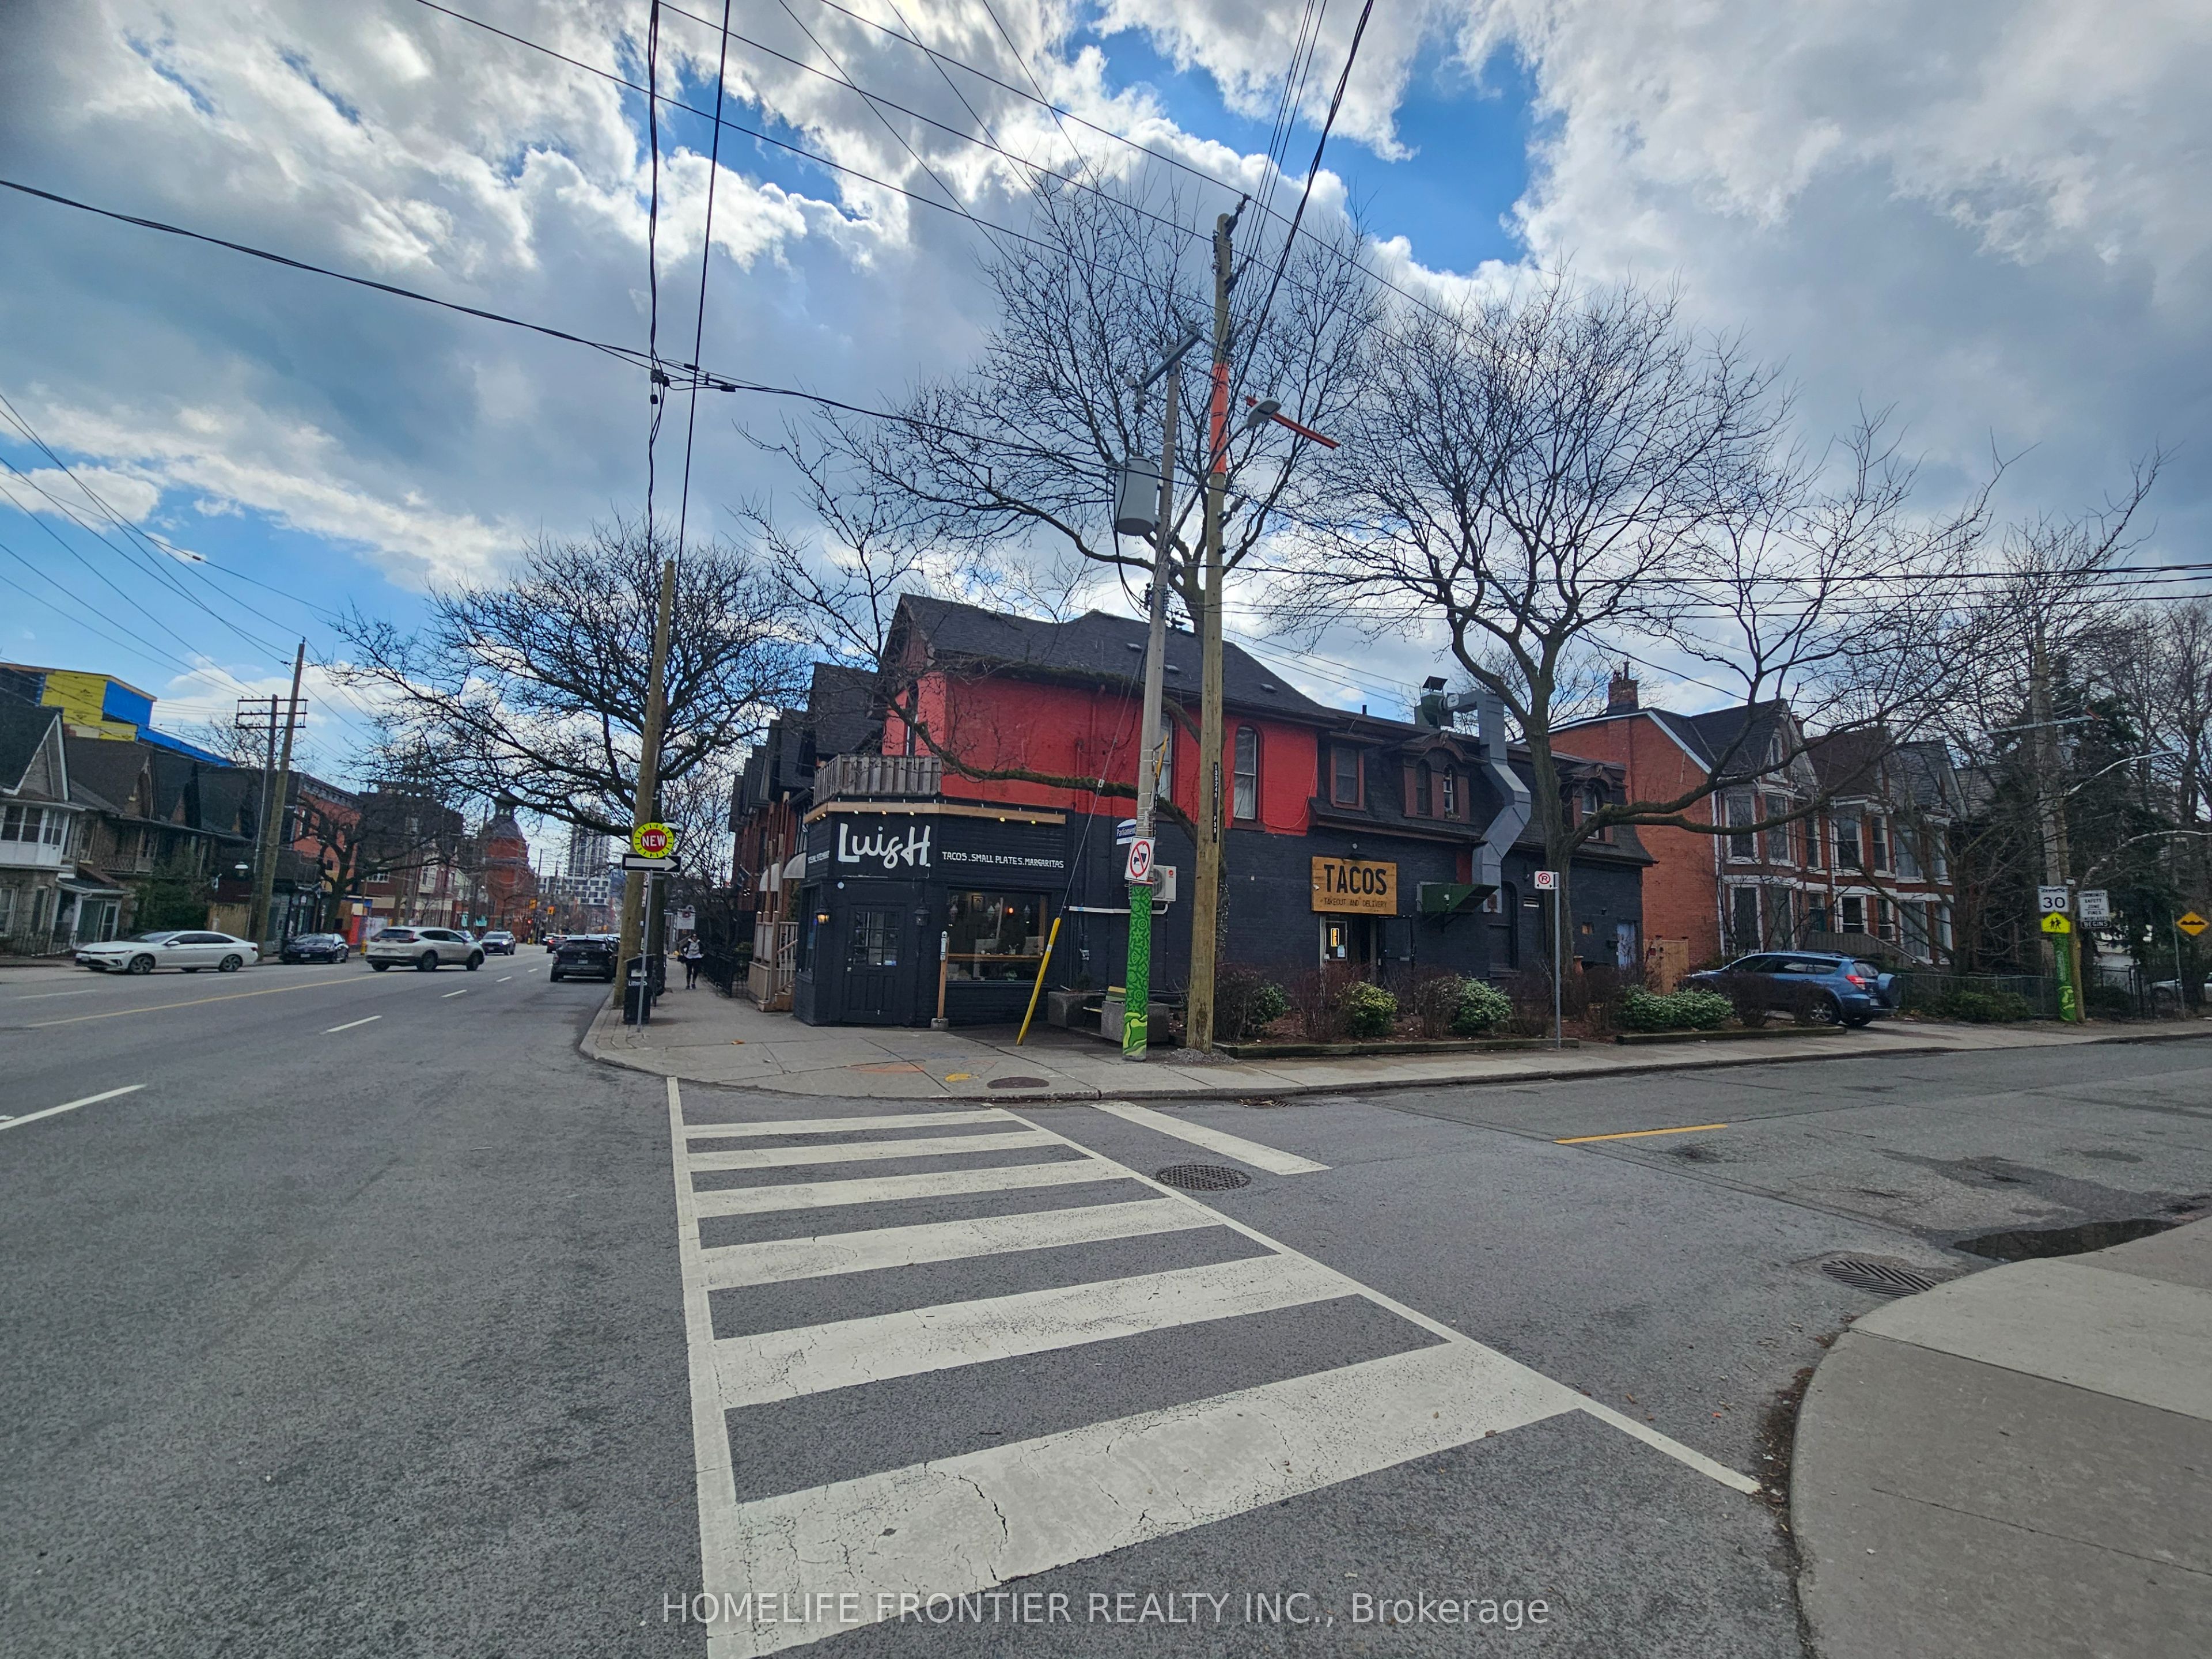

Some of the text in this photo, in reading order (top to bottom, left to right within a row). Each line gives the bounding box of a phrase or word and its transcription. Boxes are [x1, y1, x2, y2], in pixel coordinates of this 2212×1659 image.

[642, 835, 666, 847] NEW
[942, 851, 967, 861] TACOS
[1324, 864, 1387, 896] TACOS
[1324, 897, 1346, 906] TAKEOUT
[1363, 900, 1387, 908] DELIVERY
[2043, 896, 2066, 908] 30
